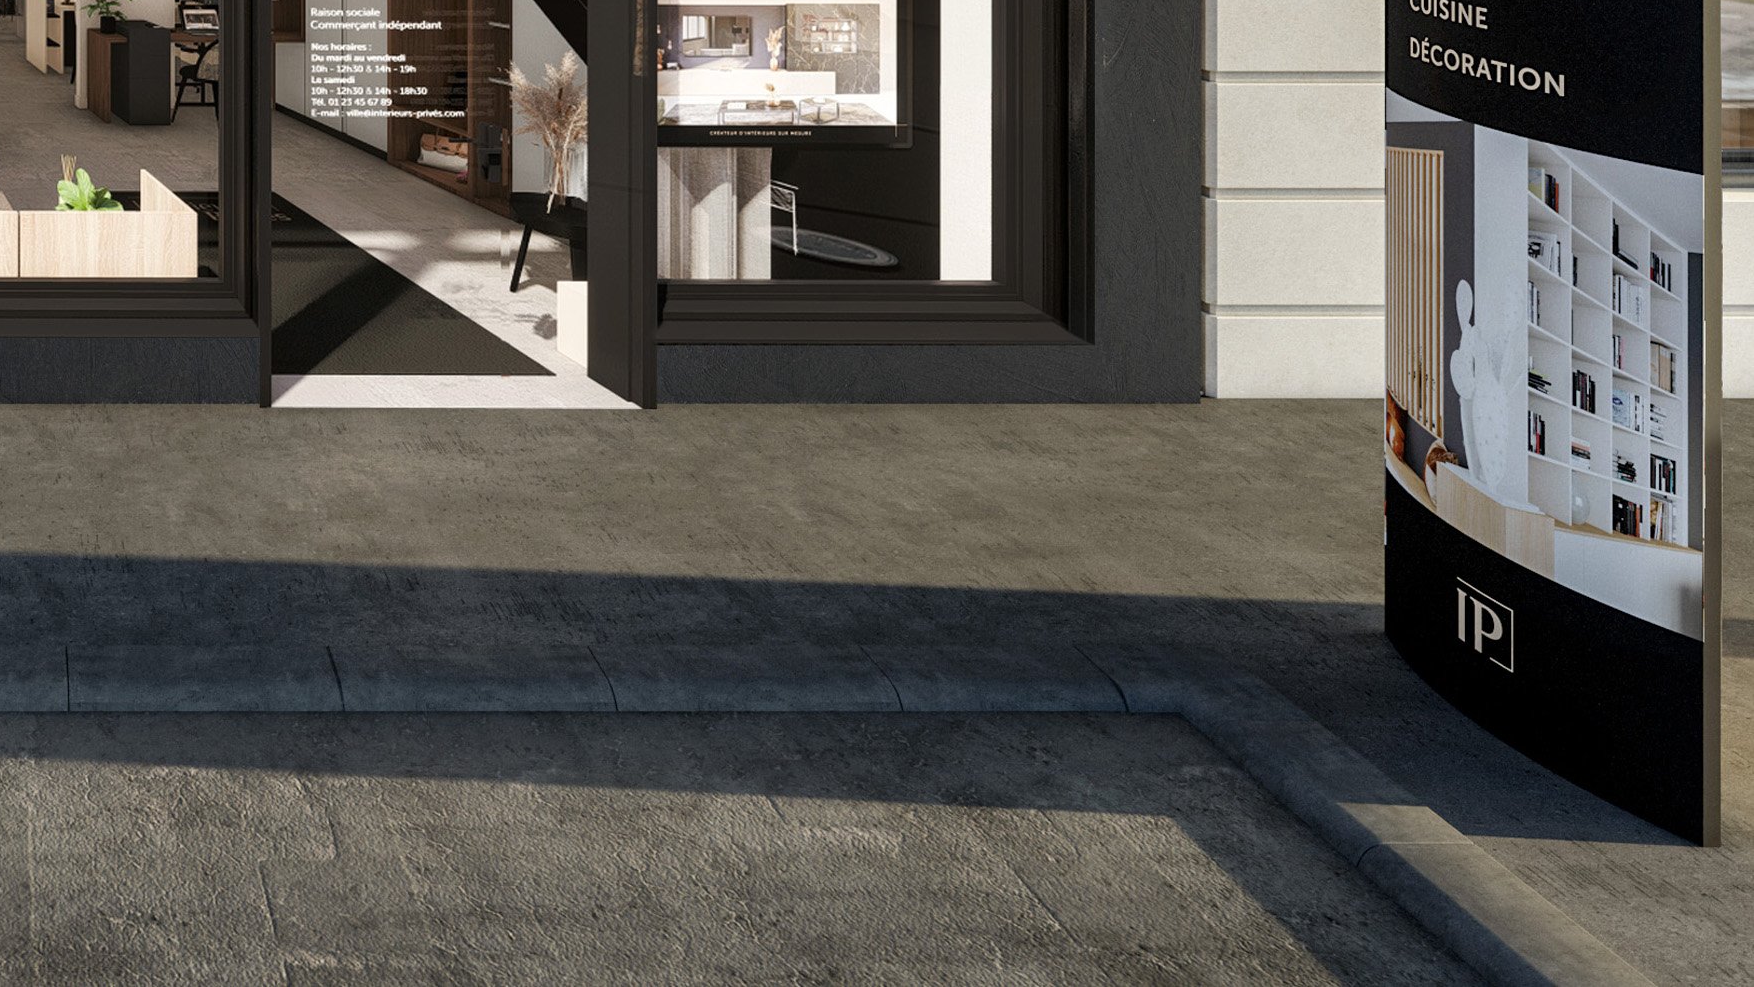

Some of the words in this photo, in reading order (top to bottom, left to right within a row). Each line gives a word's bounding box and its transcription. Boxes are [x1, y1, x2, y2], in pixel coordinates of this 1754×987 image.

[311, 7, 343, 17] Raison
[346, 7, 381, 17] sociale
[311, 20, 376, 31] Commerçant
[379, 20, 442, 31] indépendant
[311, 42, 329, 51] Nos
[330, 42, 367, 51] horaires
[311, 54, 325, 62] Du
[326, 53, 352, 62] mardi
[366, 53, 406, 62] vendredi
[311, 65, 328, 73] 10h
[336, 65, 363, 73] 12h30
[375, 65, 391, 73] 14h
[400, 65, 416, 73] 19h
[1409, 36, 1566, 97] DÉCORATION
[311, 76, 322, 84] Le
[323, 75, 355, 84] samedi
[311, 87, 328, 95] 10h
[336, 87, 363, 95] 12h30
[375, 87, 391, 95] 14h
[400, 87, 428, 95] 18h30
[328, 98, 339, 106] 01
[341, 98, 353, 106] 23
[354, 98, 366, 106] 45
[367, 98, 379, 106] 67
[380, 98, 393, 106] 89
[1456, 587, 1503, 654] IP
